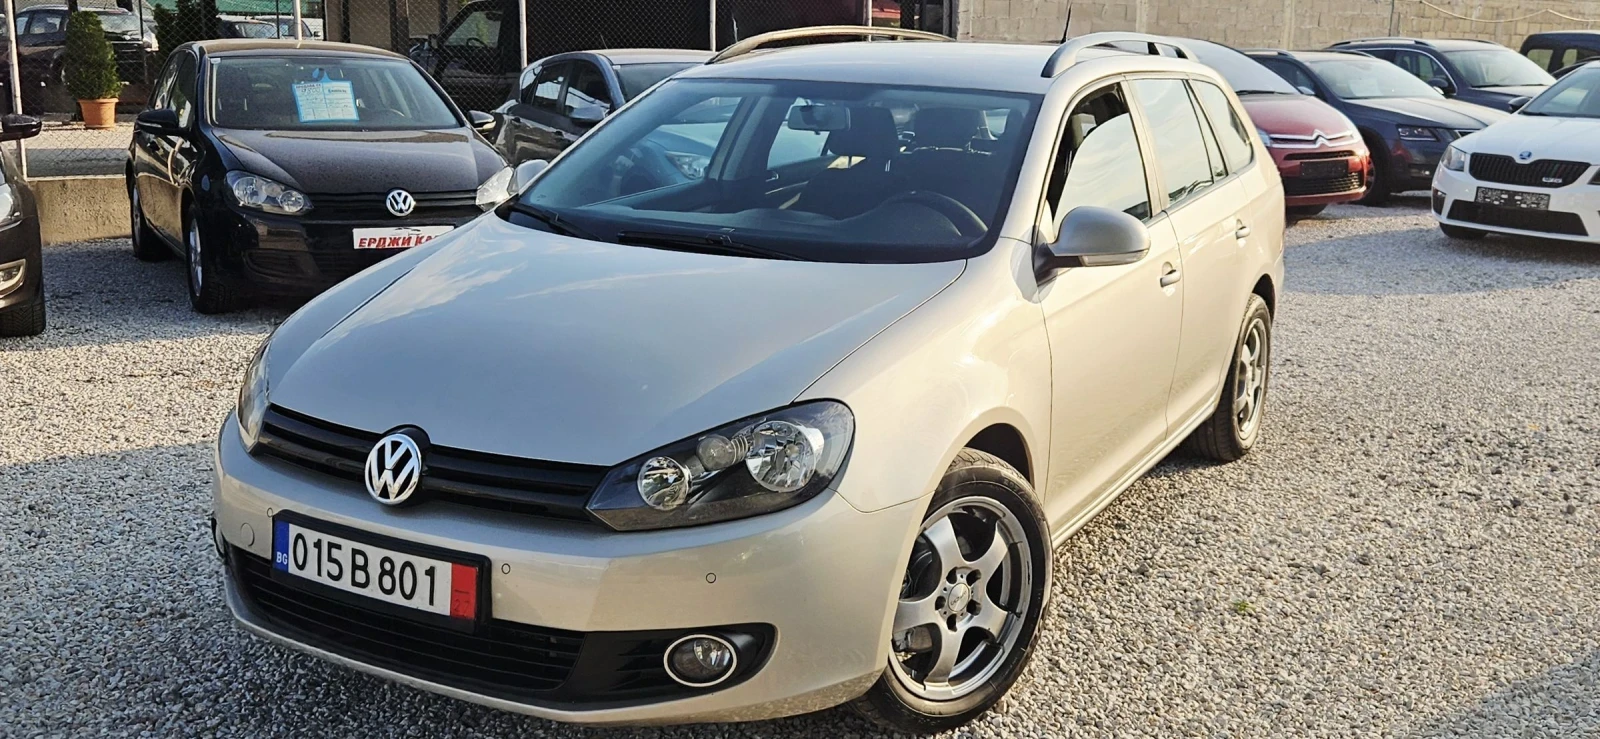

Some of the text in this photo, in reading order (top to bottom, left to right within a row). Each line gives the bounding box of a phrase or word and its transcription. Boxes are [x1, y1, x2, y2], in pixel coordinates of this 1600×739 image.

[386, 189, 415, 216] VW
[359, 236, 412, 249] ЕРДЖИ
[365, 433, 422, 505] VW
[276, 551, 288, 565] BG
